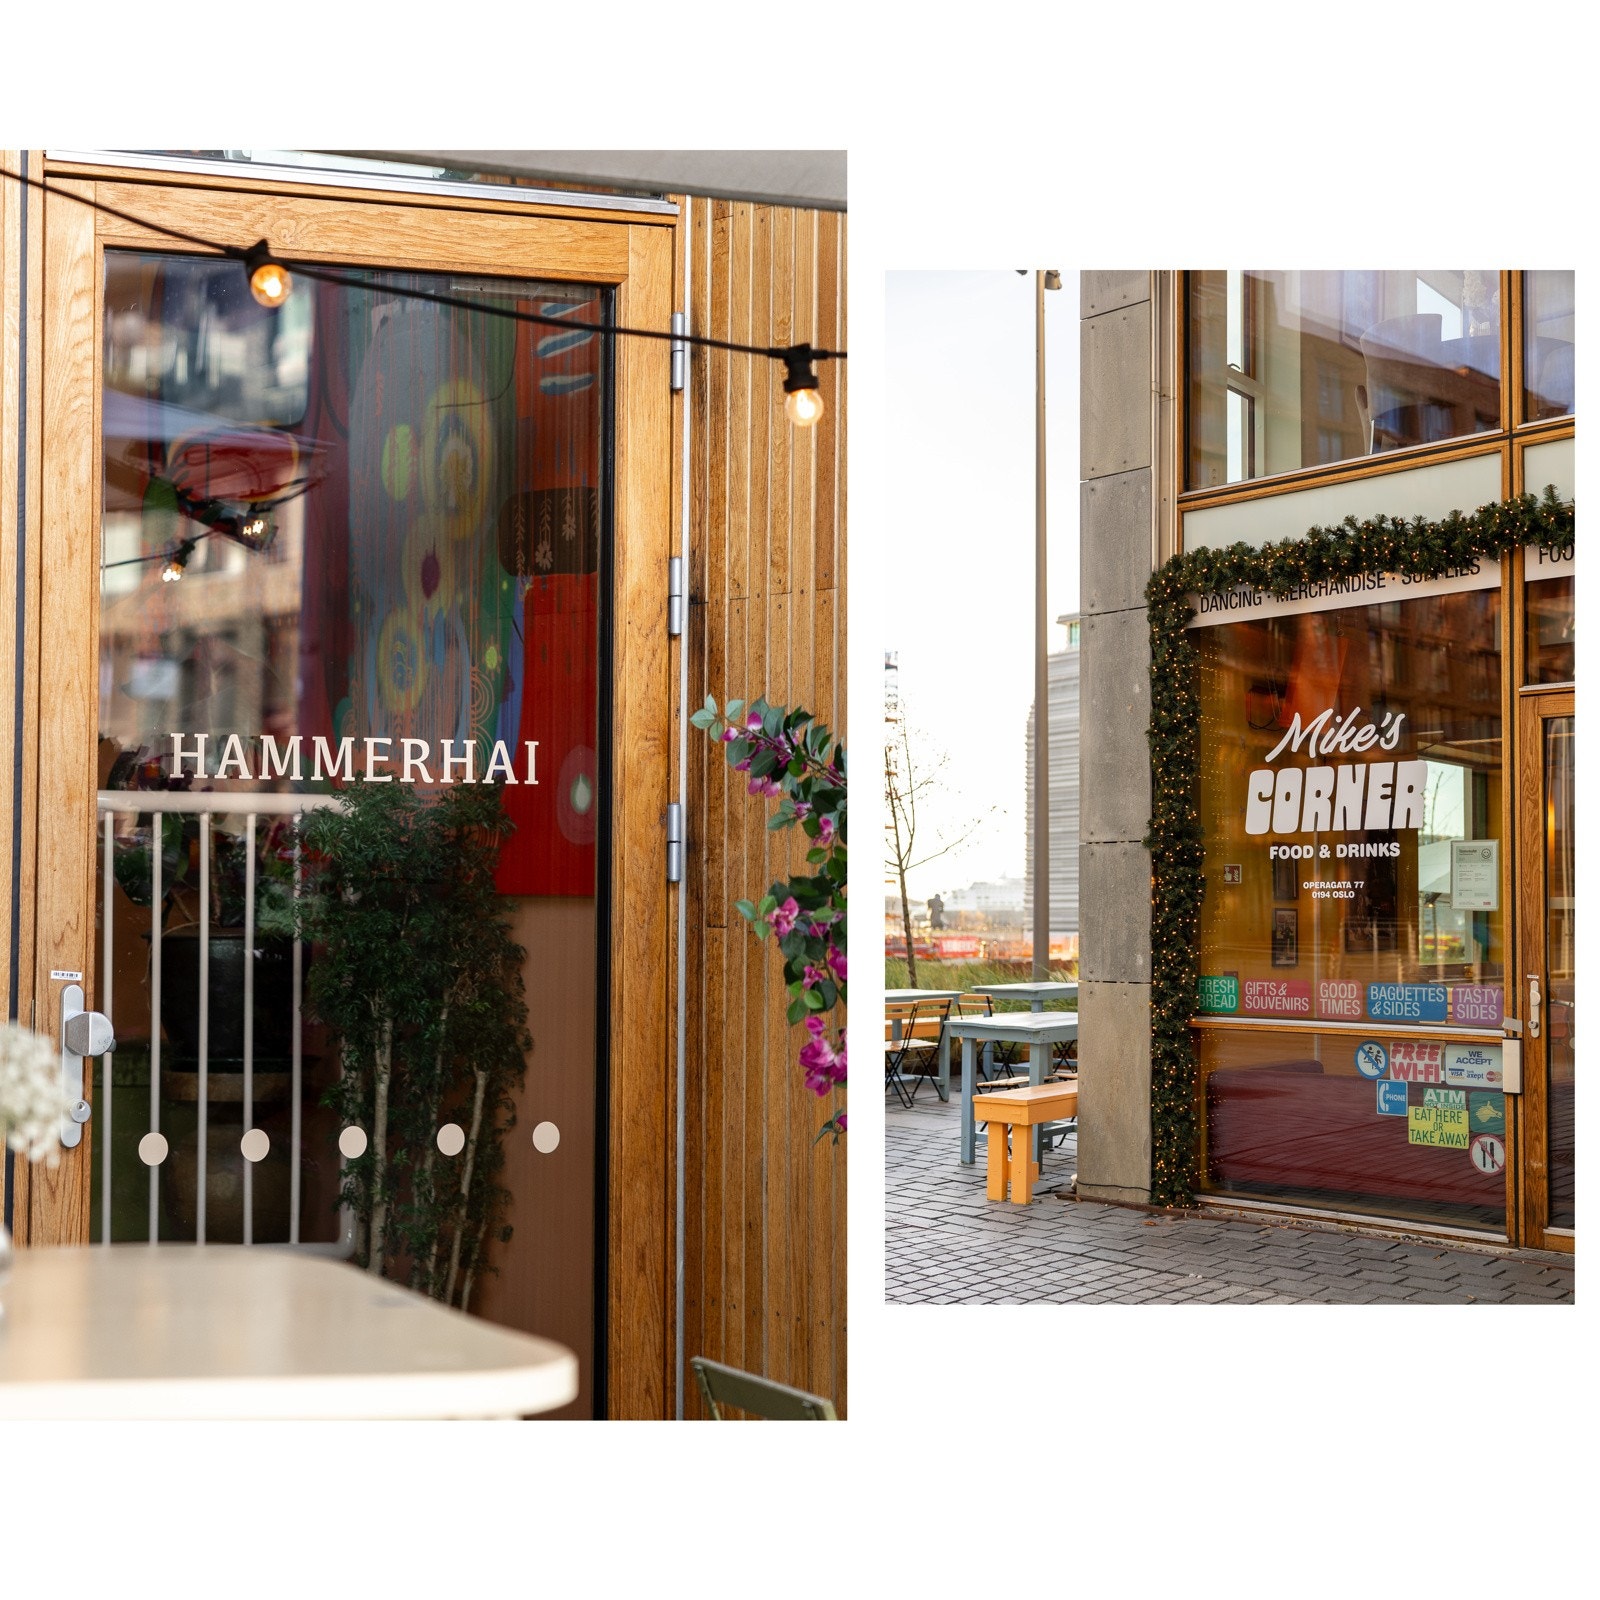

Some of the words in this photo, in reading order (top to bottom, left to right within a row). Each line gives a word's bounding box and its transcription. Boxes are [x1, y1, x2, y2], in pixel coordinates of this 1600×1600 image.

[1200, 589, 1262, 613] DANCING
[1265, 706, 1405, 763] Mike's
[170, 732, 540, 785] HAMMERHAI
[1245, 759, 1428, 835] CORNER
[1269, 845, 1314, 860] FOOD
[1319, 844, 1331, 859] &
[1336, 842, 1400, 858] DRINKS
[1303, 881, 1352, 889] OPERAGATA
[1354, 881, 1365, 889] 77
[1332, 890, 1355, 898] OSLO
[1199, 979, 1235, 994] FRESH
[1245, 981, 1277, 996] GIFTS
[1278, 983, 1287, 996] &
[1319, 983, 1357, 999] GOOD
[1370, 986, 1445, 1003] BAGUETTES
[1199, 993, 1236, 1008] BREAD
[1245, 995, 1309, 1011] SOUVENIRS
[1456, 988, 1499, 1004] TASTY
[1319, 999, 1361, 1016] TIMES
[1371, 1001, 1382, 1015] &
[1383, 1002, 1421, 1017] SIDES
[1456, 1004, 1498, 1020] SIDES
[1391, 1043, 1441, 1062] FREE
[1455, 1057, 1493, 1066] ACCEPT
[1390, 1062, 1440, 1083] WI-FI
[1385, 1094, 1406, 1102] PHONE
[1424, 1088, 1465, 1104] ATM
[1414, 1108, 1433, 1121] EAT
[1435, 1110, 1463, 1124] HERE
[1433, 1122, 1444, 1131] OR
[1410, 1129, 1435, 1144] TAKE
[1439, 1132, 1468, 1147] AWAY
